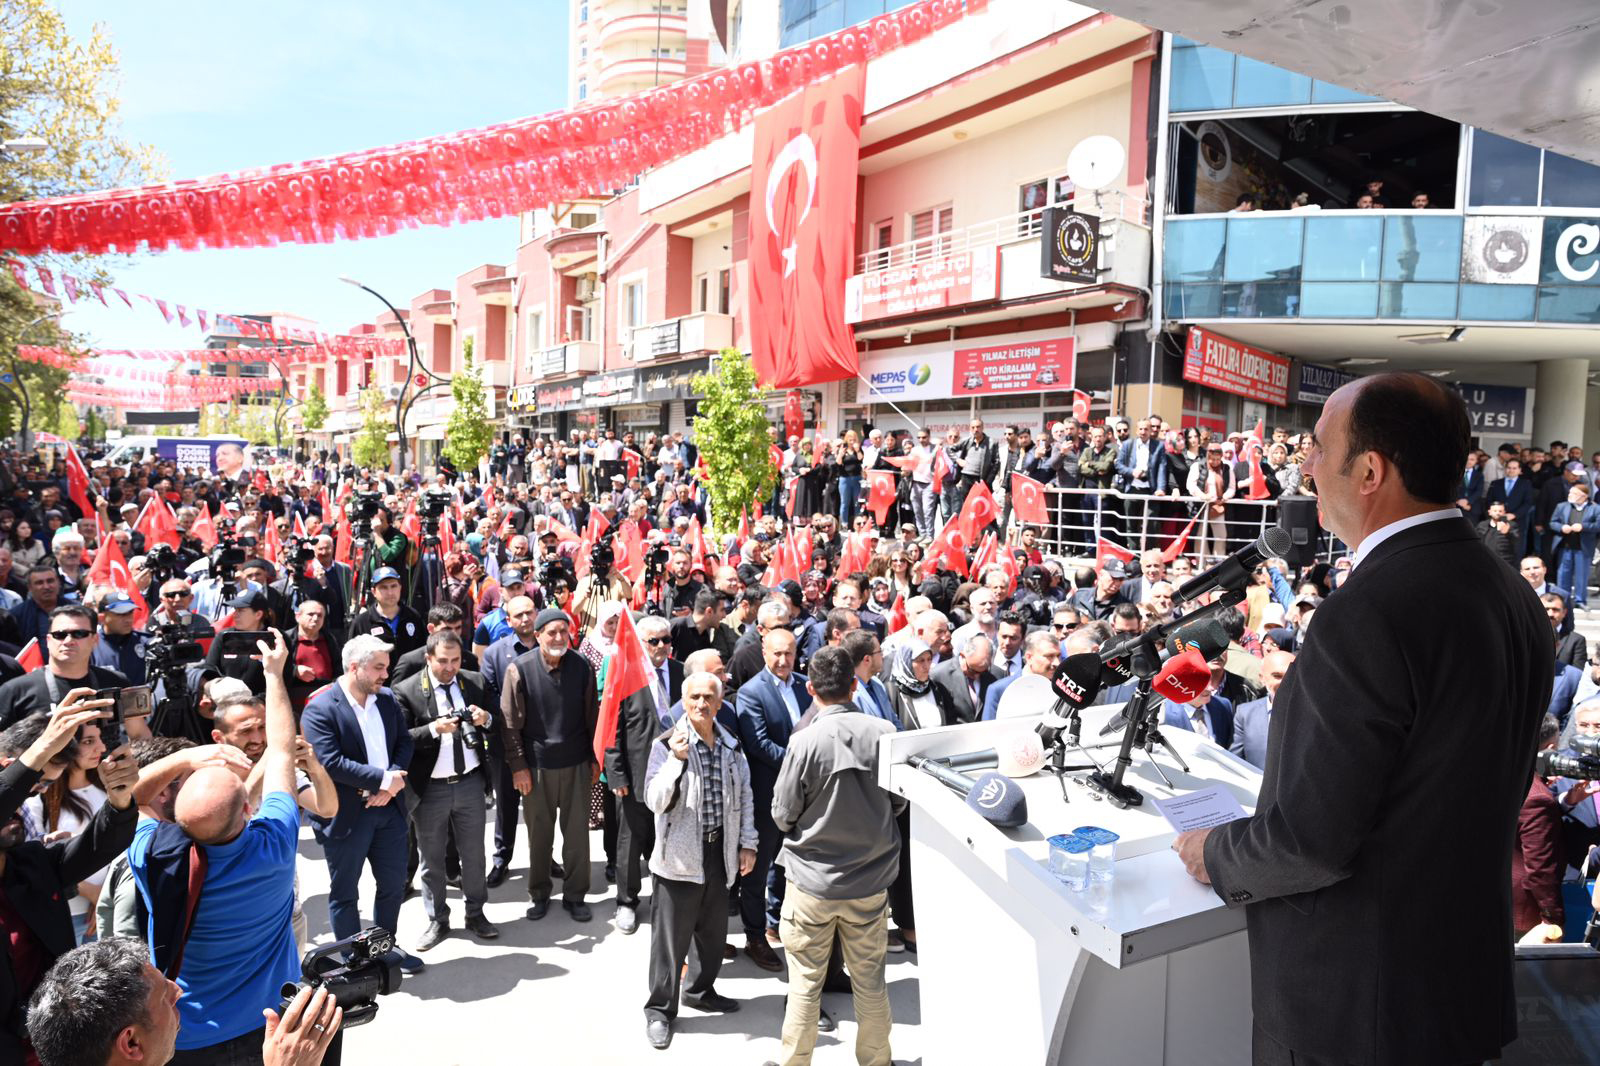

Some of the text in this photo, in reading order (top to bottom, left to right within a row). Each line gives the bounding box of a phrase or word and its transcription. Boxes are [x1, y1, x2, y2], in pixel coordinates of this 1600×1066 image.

[981, 350, 1007, 361] YILMAZ
[1008, 346, 1041, 359] İLETİŞİM
[1205, 338, 1241, 375] FATURA
[1241, 347, 1271, 383] ÖDEME
[870, 371, 906, 384] MEPAŞ
[983, 362, 1037, 375] OTO KİRALAMA
[1302, 366, 1333, 389] YILMAZ
[1055, 678, 1083, 703] HABER
[1061, 671, 1087, 696] TRT
[1165, 673, 1196, 698] DHA
